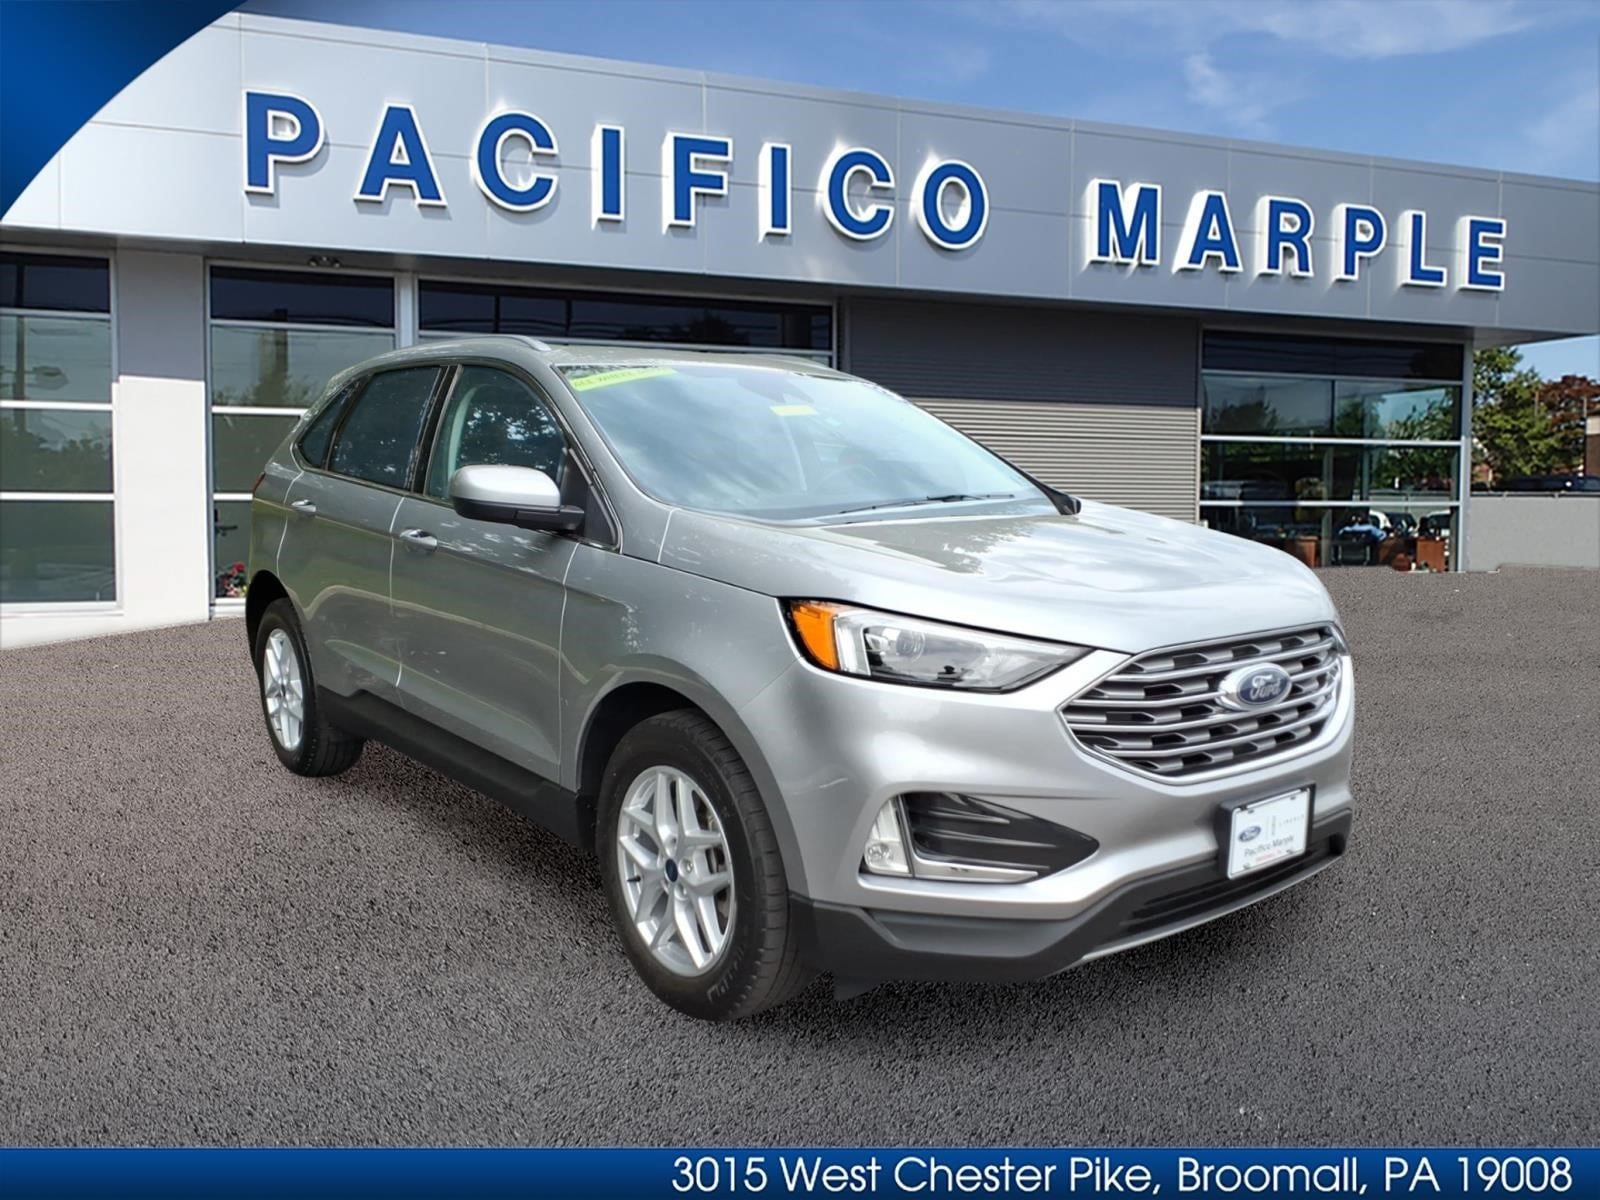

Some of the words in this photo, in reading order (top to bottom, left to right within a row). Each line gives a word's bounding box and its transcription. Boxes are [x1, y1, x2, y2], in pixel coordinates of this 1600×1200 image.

[243, 90, 990, 250] PACIFICO
[1086, 178, 1507, 292] MARPLE
[1249, 674, 1282, 701] Ford
